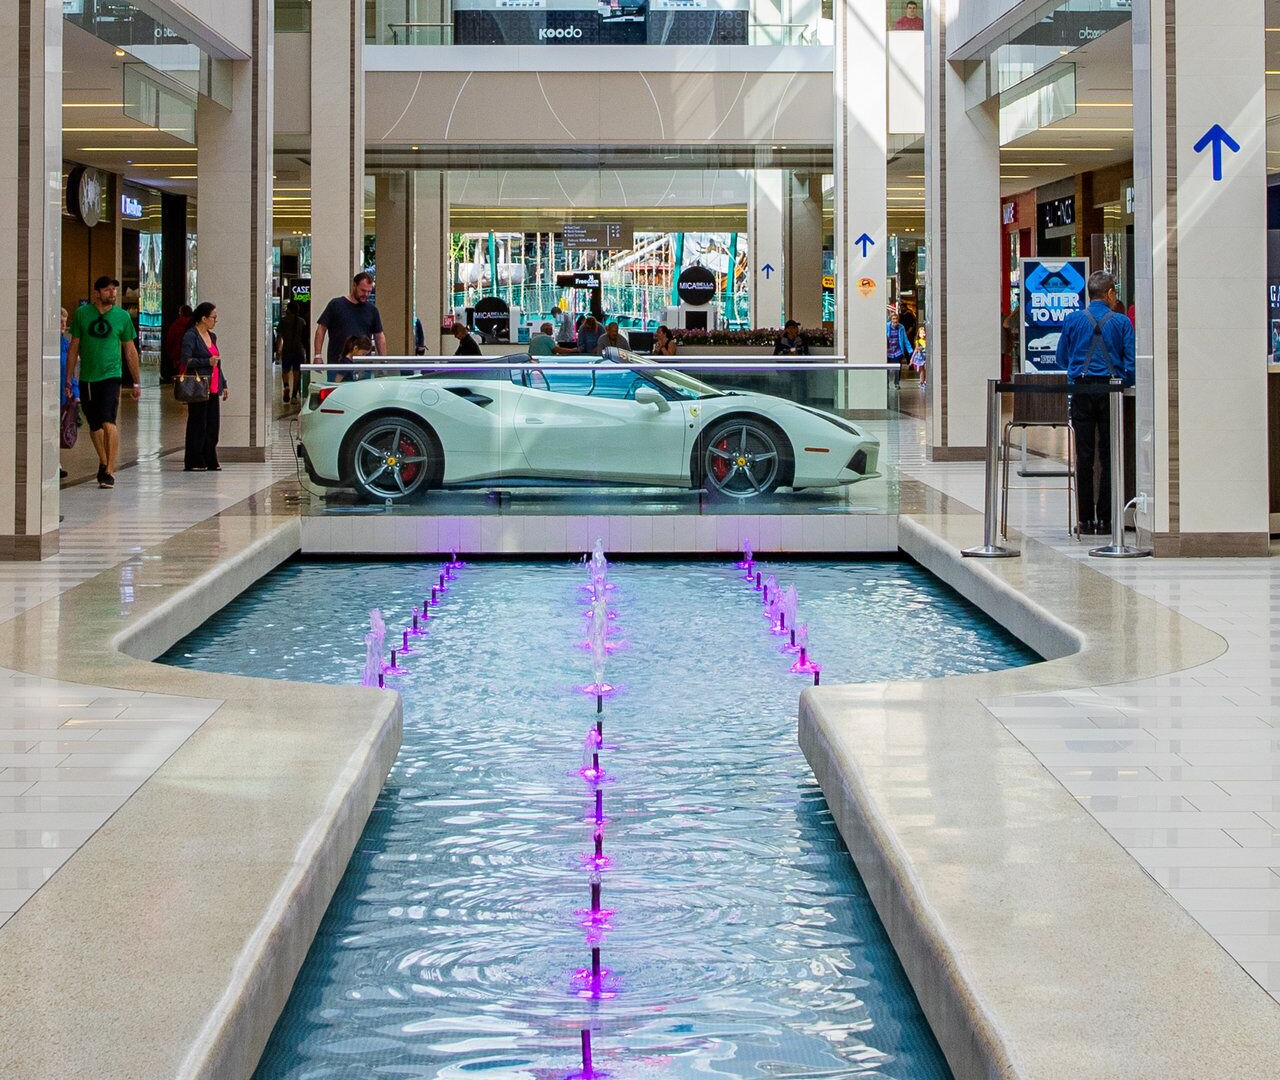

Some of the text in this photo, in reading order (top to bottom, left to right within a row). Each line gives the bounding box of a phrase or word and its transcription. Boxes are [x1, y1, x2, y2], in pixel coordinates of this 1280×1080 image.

[539, 25, 582, 40] koodo
[1031, 292, 1080, 308] ENTER
[1031, 309, 1050, 322] TO
